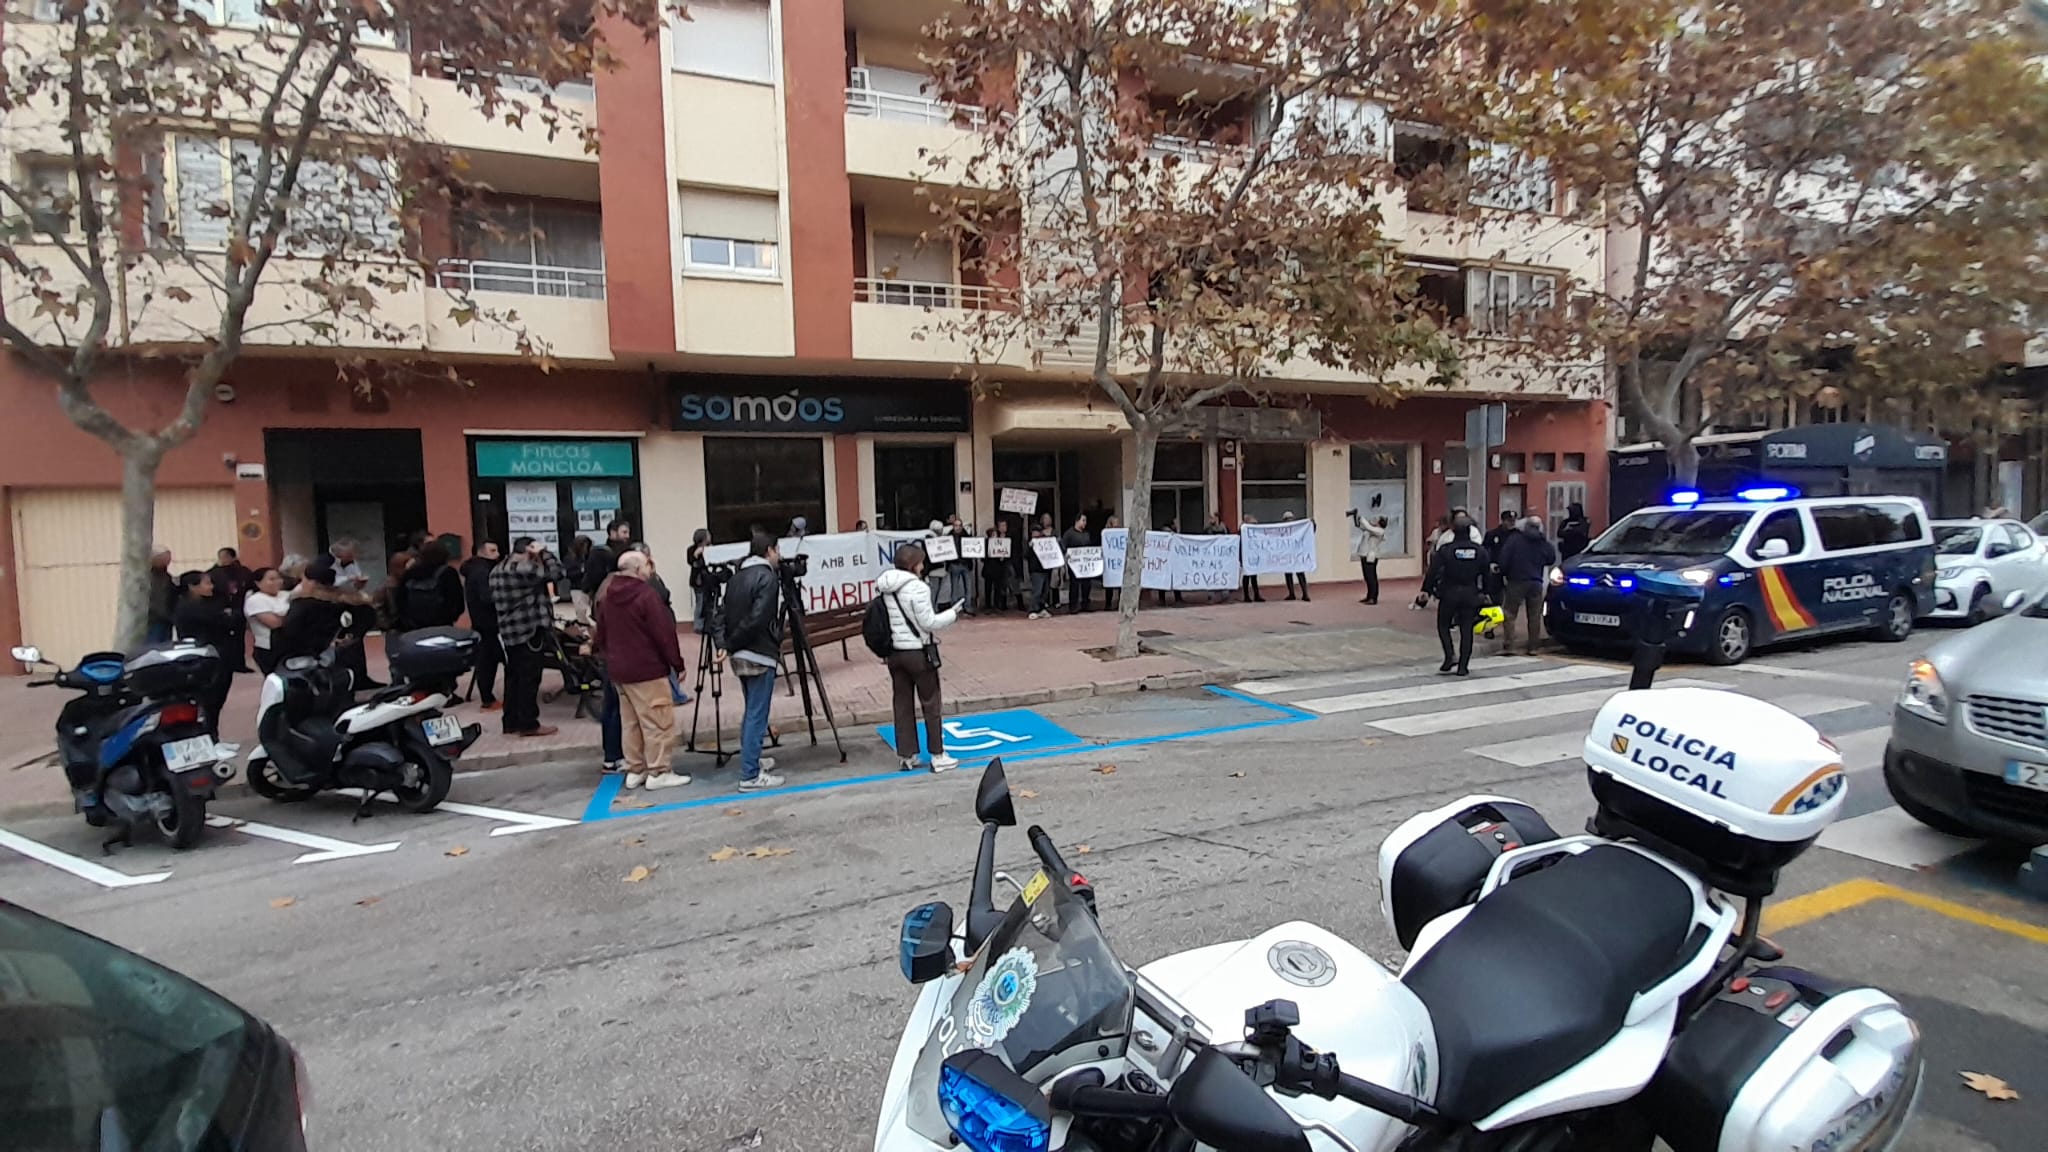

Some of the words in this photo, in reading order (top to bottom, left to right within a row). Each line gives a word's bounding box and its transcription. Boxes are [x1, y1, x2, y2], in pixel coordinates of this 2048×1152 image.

[522, 444, 591, 459] Fincas
[511, 461, 603, 474] MONCLOA
[821, 556, 845, 569] AMB
[852, 554, 868, 566] EL
[1181, 572, 1228, 587] JOVES
[1822, 585, 1890, 603] NACIONAL
[1617, 713, 1737, 771] POLICIA
[1630, 748, 1728, 799] LOCAL
